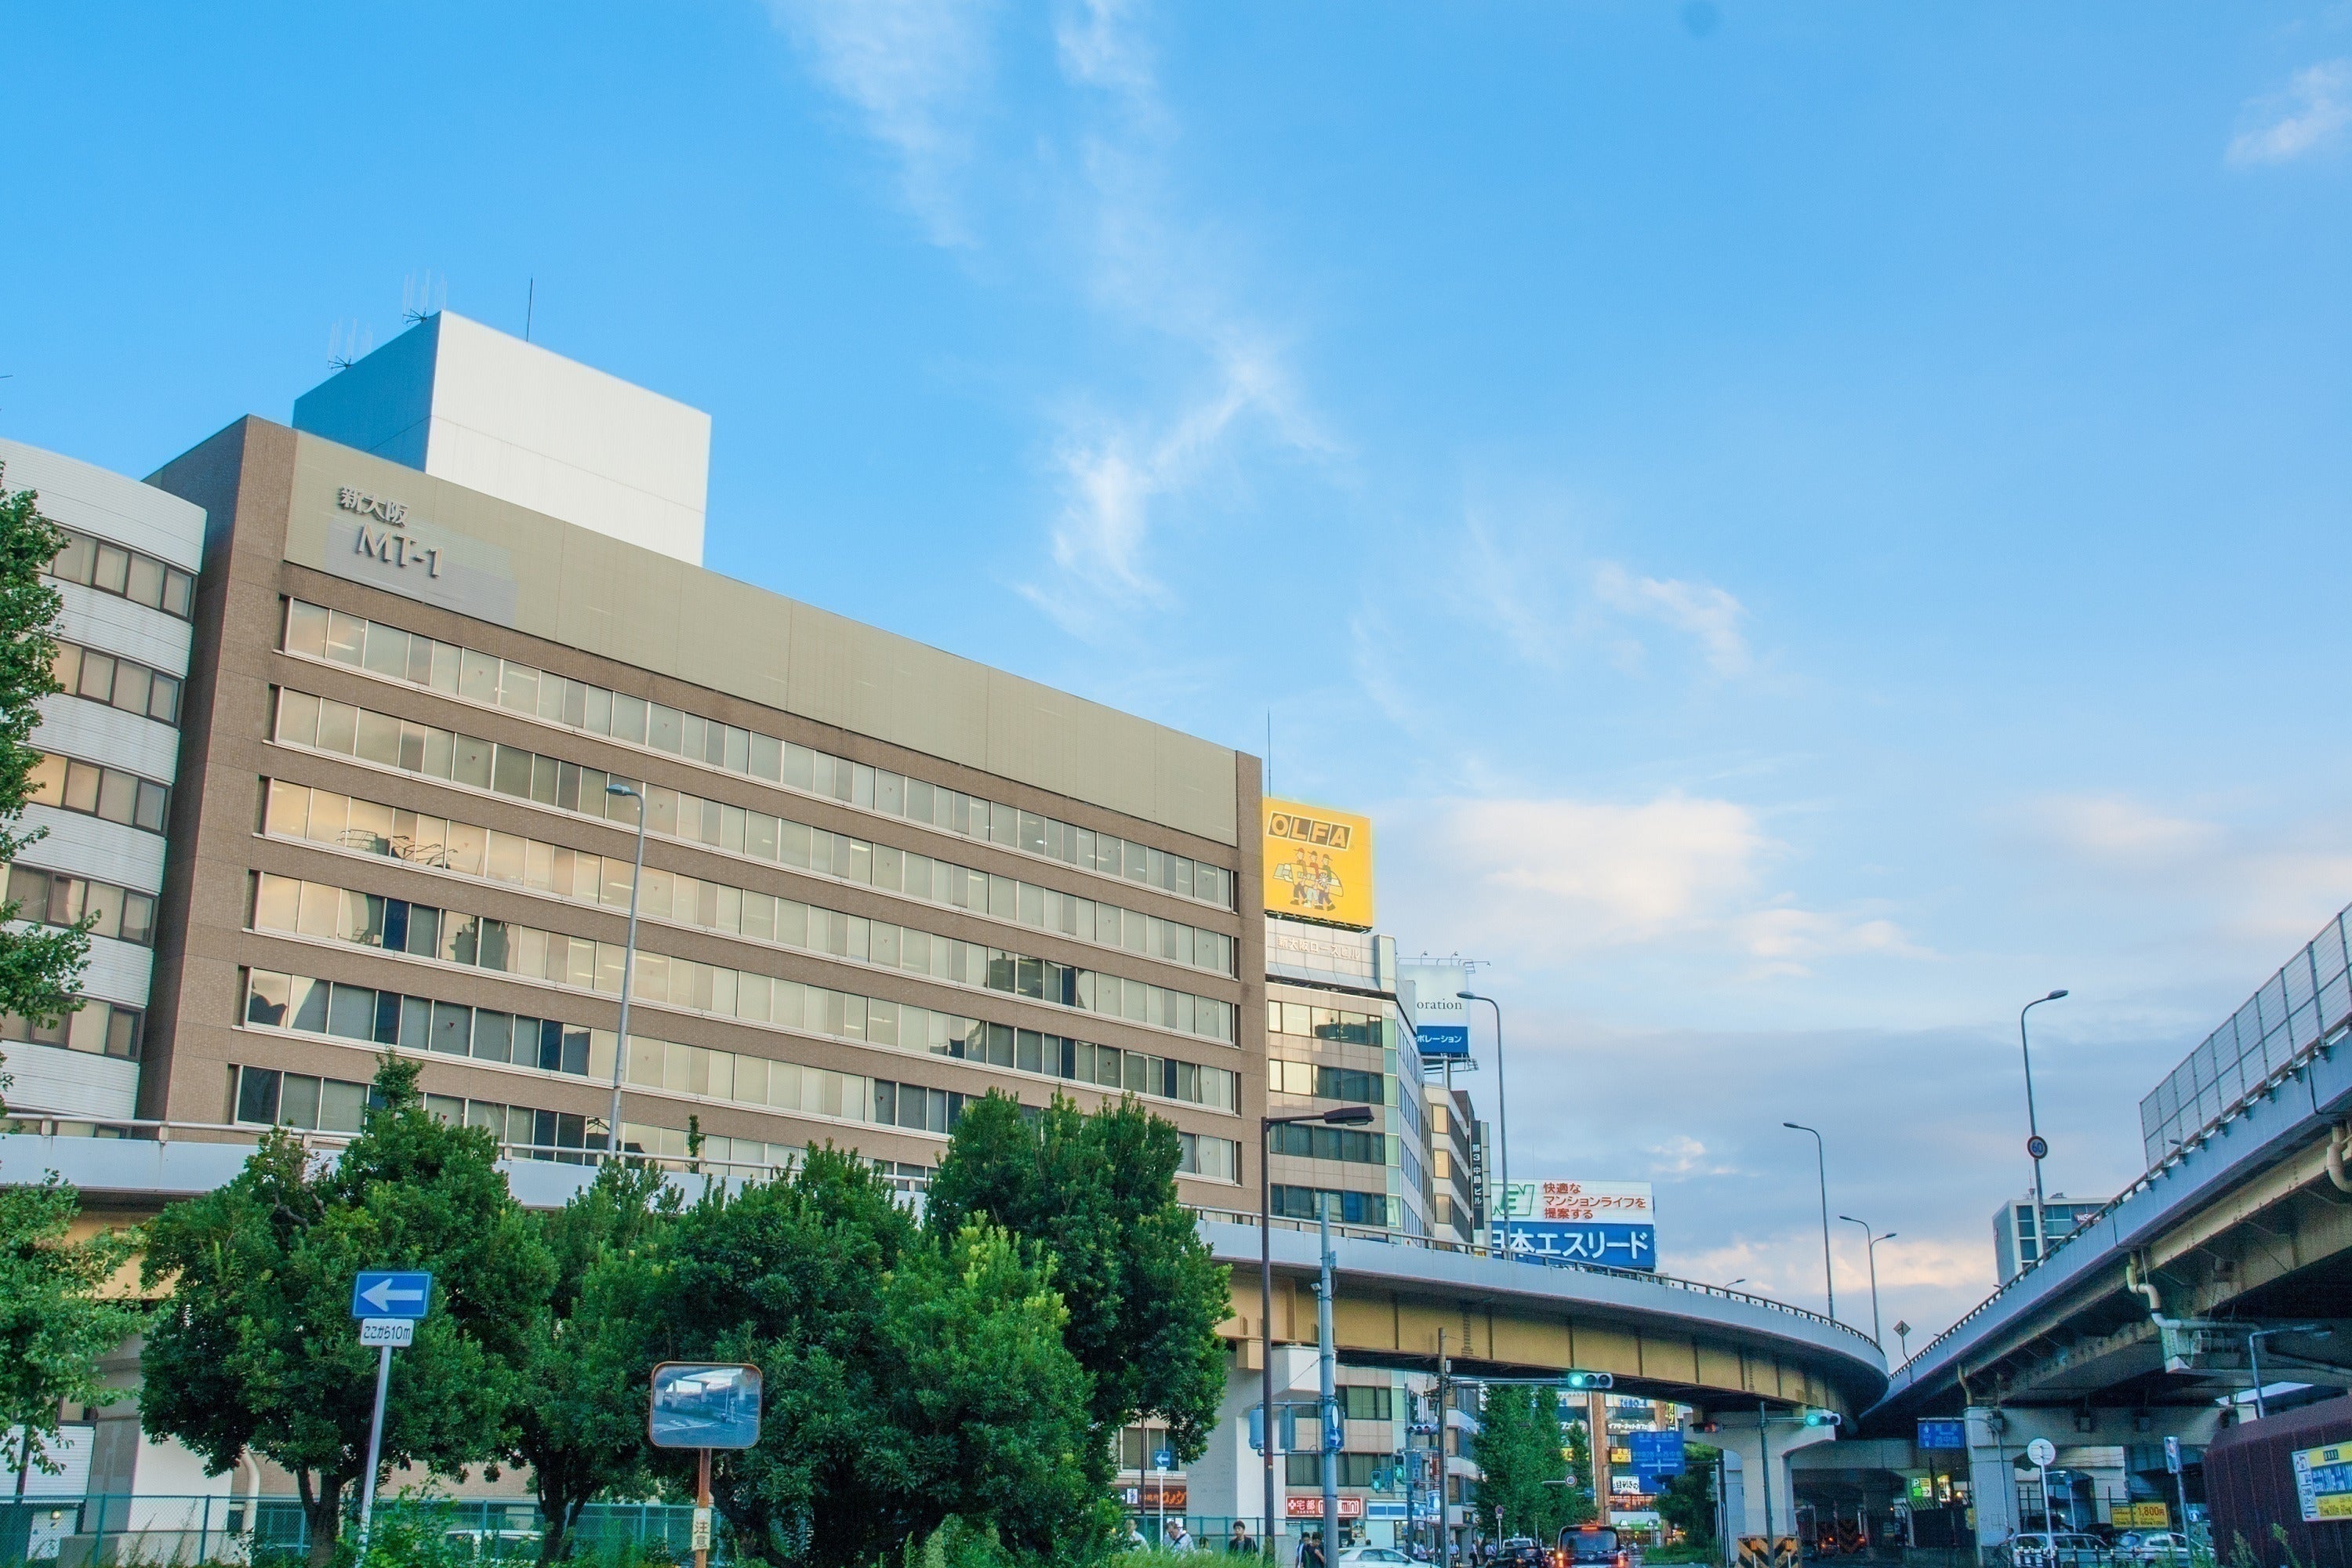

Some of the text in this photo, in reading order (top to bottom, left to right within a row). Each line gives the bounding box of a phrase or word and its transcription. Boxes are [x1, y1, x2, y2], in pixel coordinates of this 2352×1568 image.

[338, 485, 409, 527] 新大阪
[358, 523, 444, 578] MT-1
[1269, 813, 1348, 848] OLFA
[1416, 998, 1462, 1010] oration
[2031, 1142, 2044, 1153] 60
[1543, 1182, 1581, 1194] 快適な
[1544, 1196, 1646, 1209] マンションライフを
[1544, 1207, 1594, 1220] 提案する
[364, 1326, 411, 1340] ここから10m
[1296, 1499, 1316, 1510] 宅都
[694, 1521, 710, 1548] 注意
